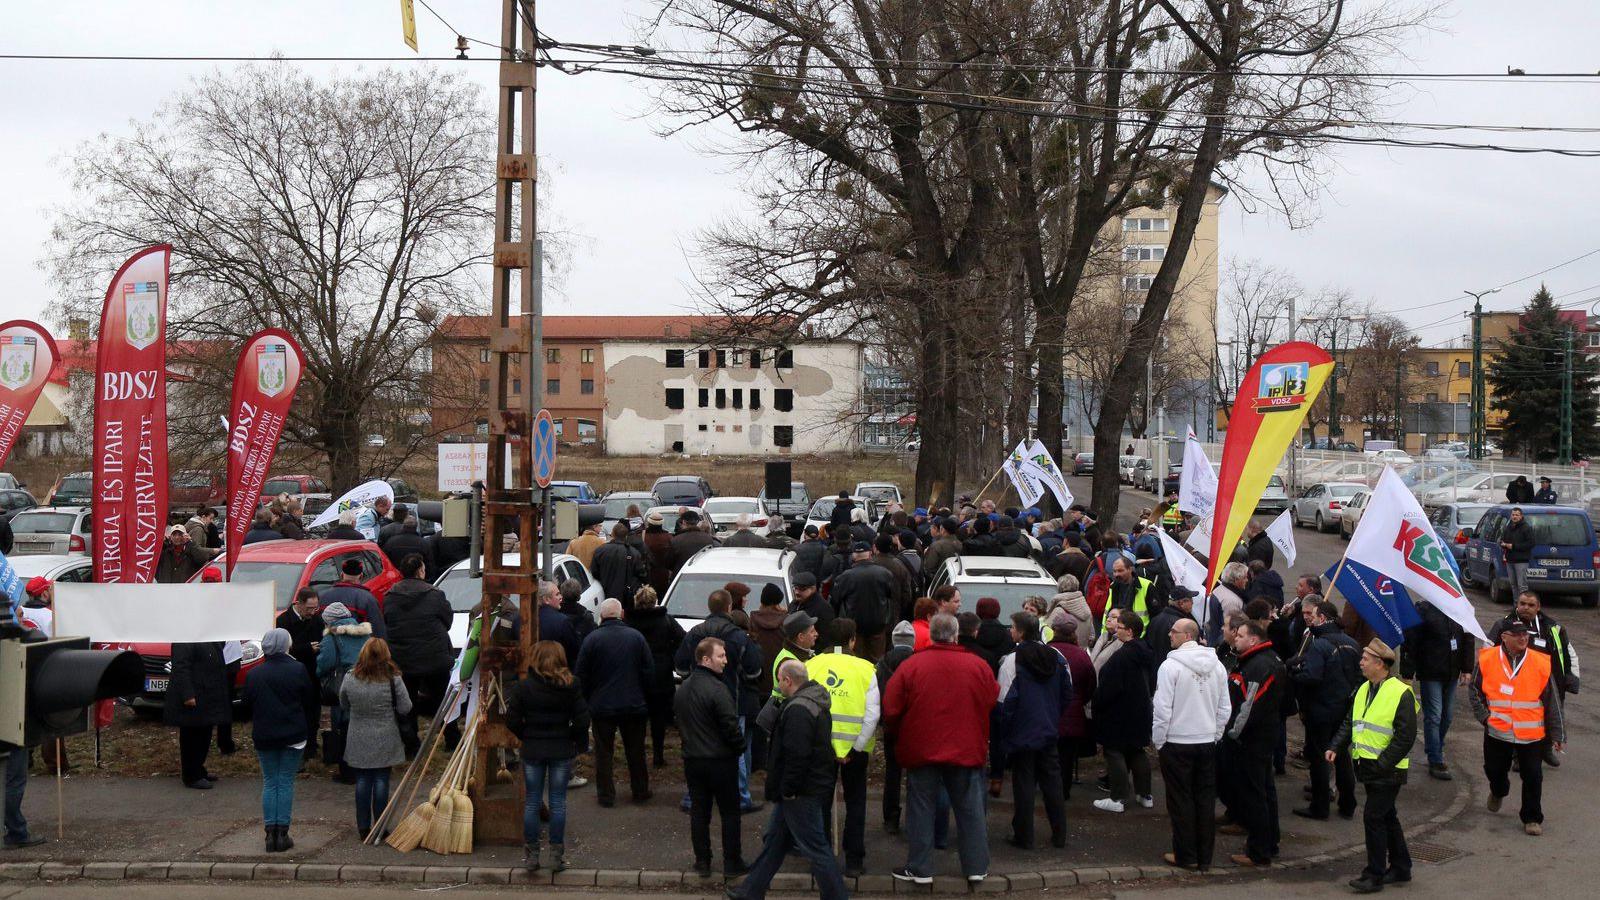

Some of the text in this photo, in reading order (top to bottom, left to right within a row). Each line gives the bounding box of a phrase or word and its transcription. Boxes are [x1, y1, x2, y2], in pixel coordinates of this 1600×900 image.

[103, 370, 158, 401] BDSZ
[1271, 397, 1292, 405] VDSZ
[230, 401, 258, 454] BDSZ
[258, 410, 273, 435] IPARI
[103, 420, 123, 474] IPARI
[250, 413, 284, 490] SZAKSZERVEZETE
[100, 478, 124, 503] ÉS
[135, 413, 157, 583] ZAKSZERVEZETE
